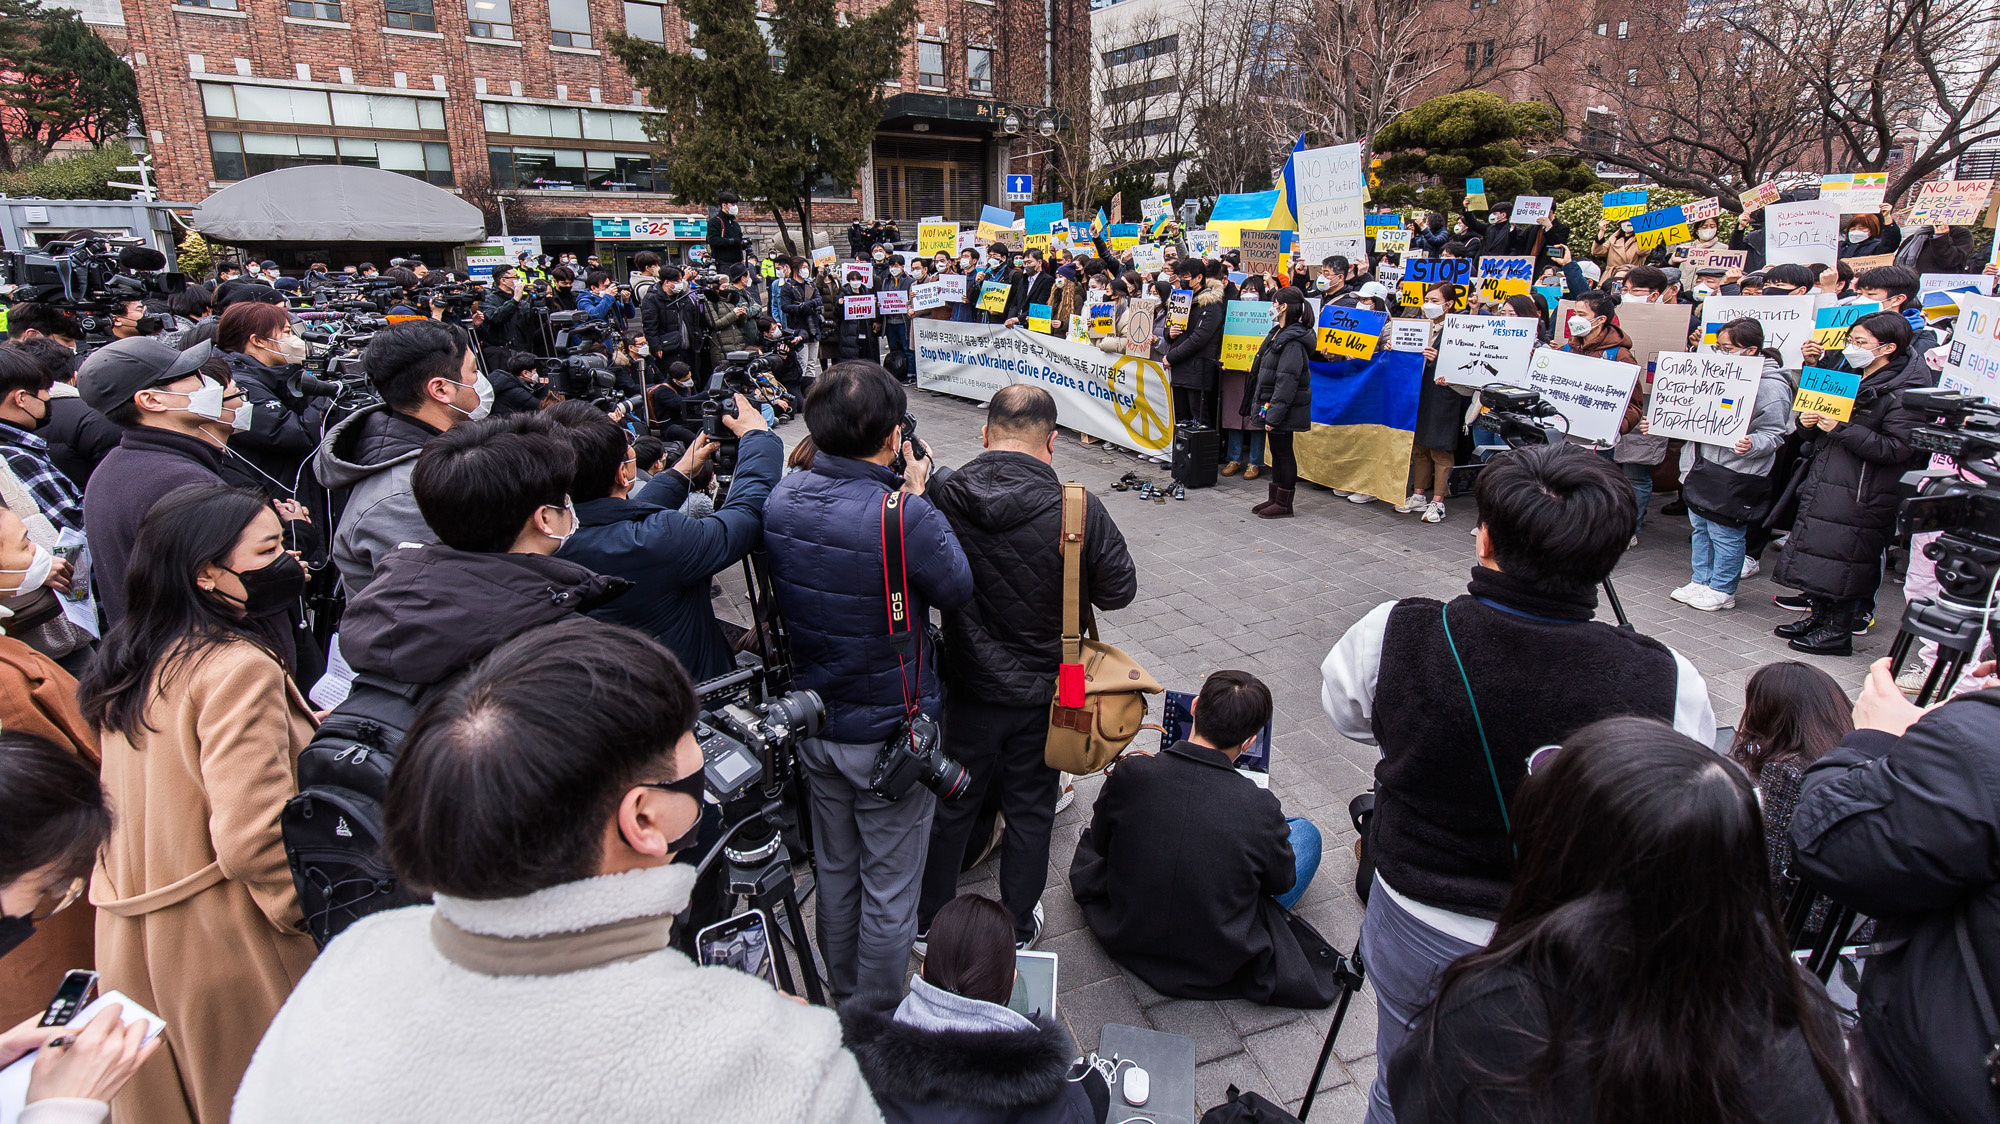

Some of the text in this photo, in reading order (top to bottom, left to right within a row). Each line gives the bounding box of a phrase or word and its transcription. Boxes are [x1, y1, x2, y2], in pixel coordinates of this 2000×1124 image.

[1301, 155, 1357, 179] NO War
[1303, 180, 1359, 202] NO Putin
[1923, 181, 1987, 194] NO WAR
[1918, 195, 1966, 210] 전쟁을
[1303, 205, 1328, 223] Stand
[1371, 215, 1395, 225] НЕТ
[1697, 208, 1718, 219] OUT
[1929, 208, 1978, 219] 멈춰라!
[1642, 213, 1664, 229] NO
[635, 223, 667, 236] GS25
[937, 229, 953, 238] WAR
[1241, 230, 1280, 240] WITHDRAW
[1382, 230, 1407, 240] STOP
[1026, 235, 1047, 244] PUTIN
[1640, 227, 1682, 247] WAR
[920, 242, 928, 250] IN
[930, 241, 954, 250] UKRAINE
[1132, 246, 1153, 257] Stand
[1243, 240, 1278, 250] RUSSIAN
[1381, 242, 1405, 251] WAR
[1245, 249, 1277, 259] TROOPS
[1247, 261, 1278, 275] NOW
[1709, 255, 1743, 268] PUTIN
[1412, 258, 1470, 284] STOP
[1484, 263, 1523, 276] War has
[1481, 278, 1498, 290] NO
[1170, 291, 1186, 303] Give
[1402, 290, 1419, 304] the
[1169, 302, 1189, 314] Peace
[1329, 310, 1360, 331] Stop
[1830, 307, 1860, 327] NO
[1967, 310, 1987, 335] no
[1447, 318, 1506, 333] We support WAR
[1492, 328, 1529, 338] RESISTERS
[1126, 339, 1152, 352] NOT WAR
[1325, 329, 1367, 352] the War
[1480, 341, 1499, 350] Russia
[919, 330, 938, 342] 러시아의
[939, 332, 964, 346] 우크라이나
[964, 335, 977, 347] 침공
[977, 335, 990, 348] 중단
[994, 337, 1013, 351] 평화적
[1014, 339, 1029, 354] 해결
[1030, 343, 1044, 359] 촉구
[1073, 358, 1089, 374] 공동
[1091, 363, 1126, 385] 기자회견
[1660, 356, 1698, 377] Слава
[1968, 353, 1999, 380] 더이상
[920, 346, 1137, 410] Stop the War in Give Peace a Chance!
[1531, 370, 1548, 382] 우리는
[1795, 392, 1841, 416] Нет Войне
[891, 592, 904, 621] EOS
